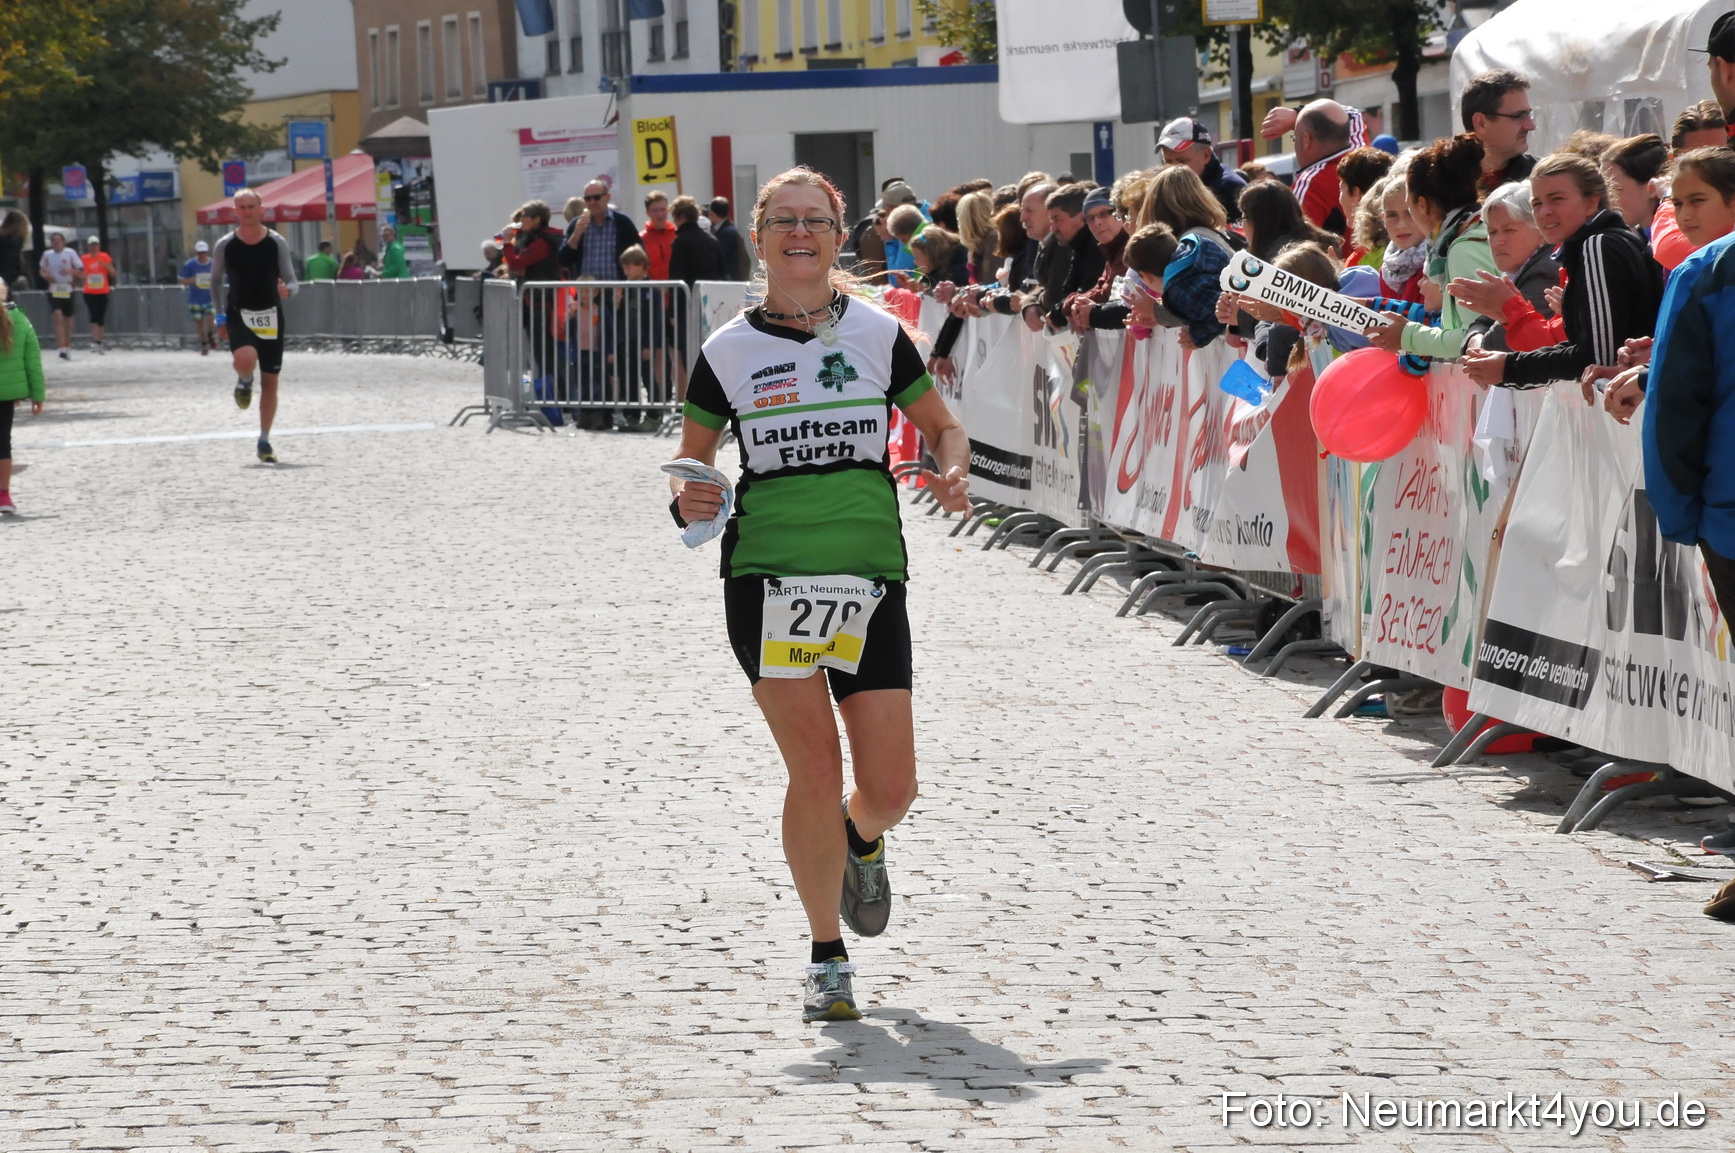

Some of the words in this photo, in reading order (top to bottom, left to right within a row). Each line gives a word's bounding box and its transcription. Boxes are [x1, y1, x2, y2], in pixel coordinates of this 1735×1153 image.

[637, 119, 671, 133] Block
[541, 155, 587, 167] DAHMIT
[645, 138, 668, 169] D
[1271, 270, 1319, 303] BMW
[249, 316, 270, 327] 163
[753, 378, 789, 390] SYNERGY
[761, 382, 793, 393] SPORTS
[753, 392, 800, 408] OBI
[752, 419, 878, 446] Laufteam
[779, 441, 855, 464] Fürth
[768, 586, 807, 597] PARTL
[810, 585, 866, 596] Neumarkt
[1377, 593, 1442, 655] BESSER
[1528, 656, 1549, 680] die
